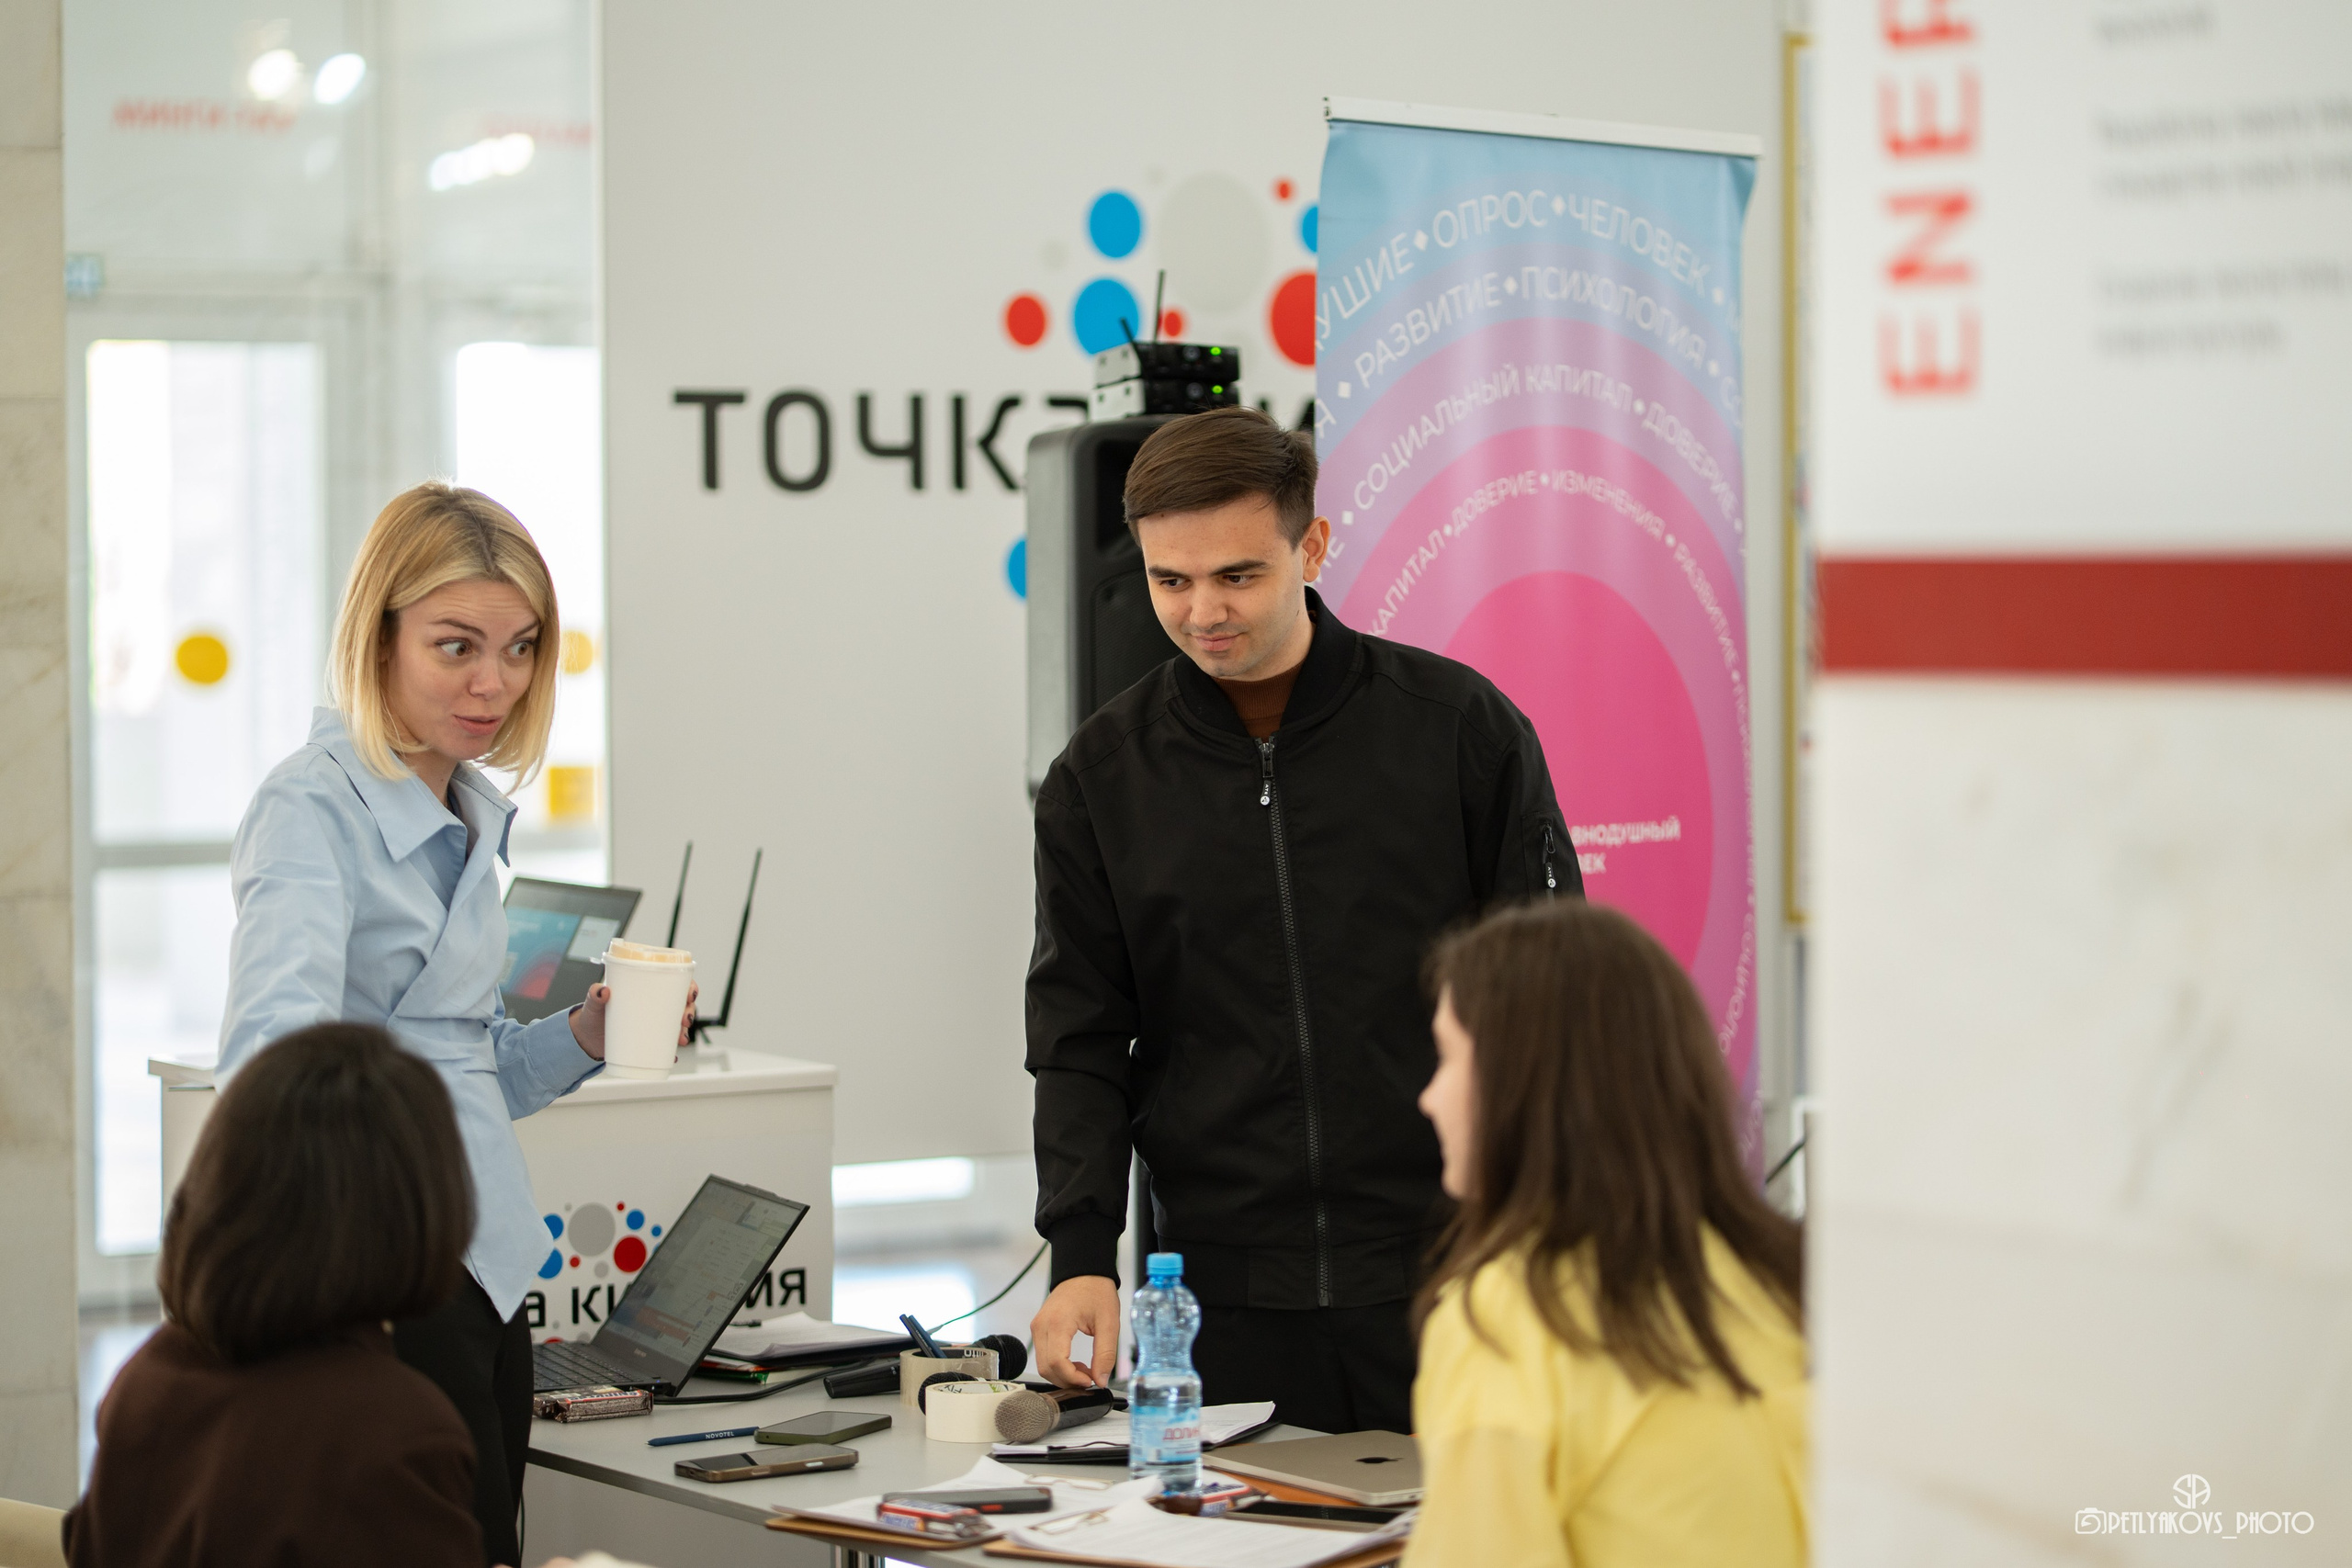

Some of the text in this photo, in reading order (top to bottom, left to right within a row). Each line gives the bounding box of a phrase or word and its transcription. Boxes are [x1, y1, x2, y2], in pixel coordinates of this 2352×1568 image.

[1316, 190, 1717, 351] УШИЕ ОПРОС ЧЕЛОВЕК
[1354, 273, 1502, 389] РАЗВИТИЕ
[1521, 265, 1707, 367] ПСИХОЛОГИЯ
[1354, 364, 1521, 511] СОЦИАЛЬНЫЙ
[1524, 364, 1633, 414] КАПИТАЛ
[1641, 401, 1739, 520] ДОВЕРИЕ
[1368, 529, 1445, 636] КАПИТАЛ
[1451, 469, 1539, 537] ДОВЕРИЕ
[1552, 468, 1667, 540] ИЗМЕНЕНИЯ
[706, 1430, 735, 1439] NOVOTEL
